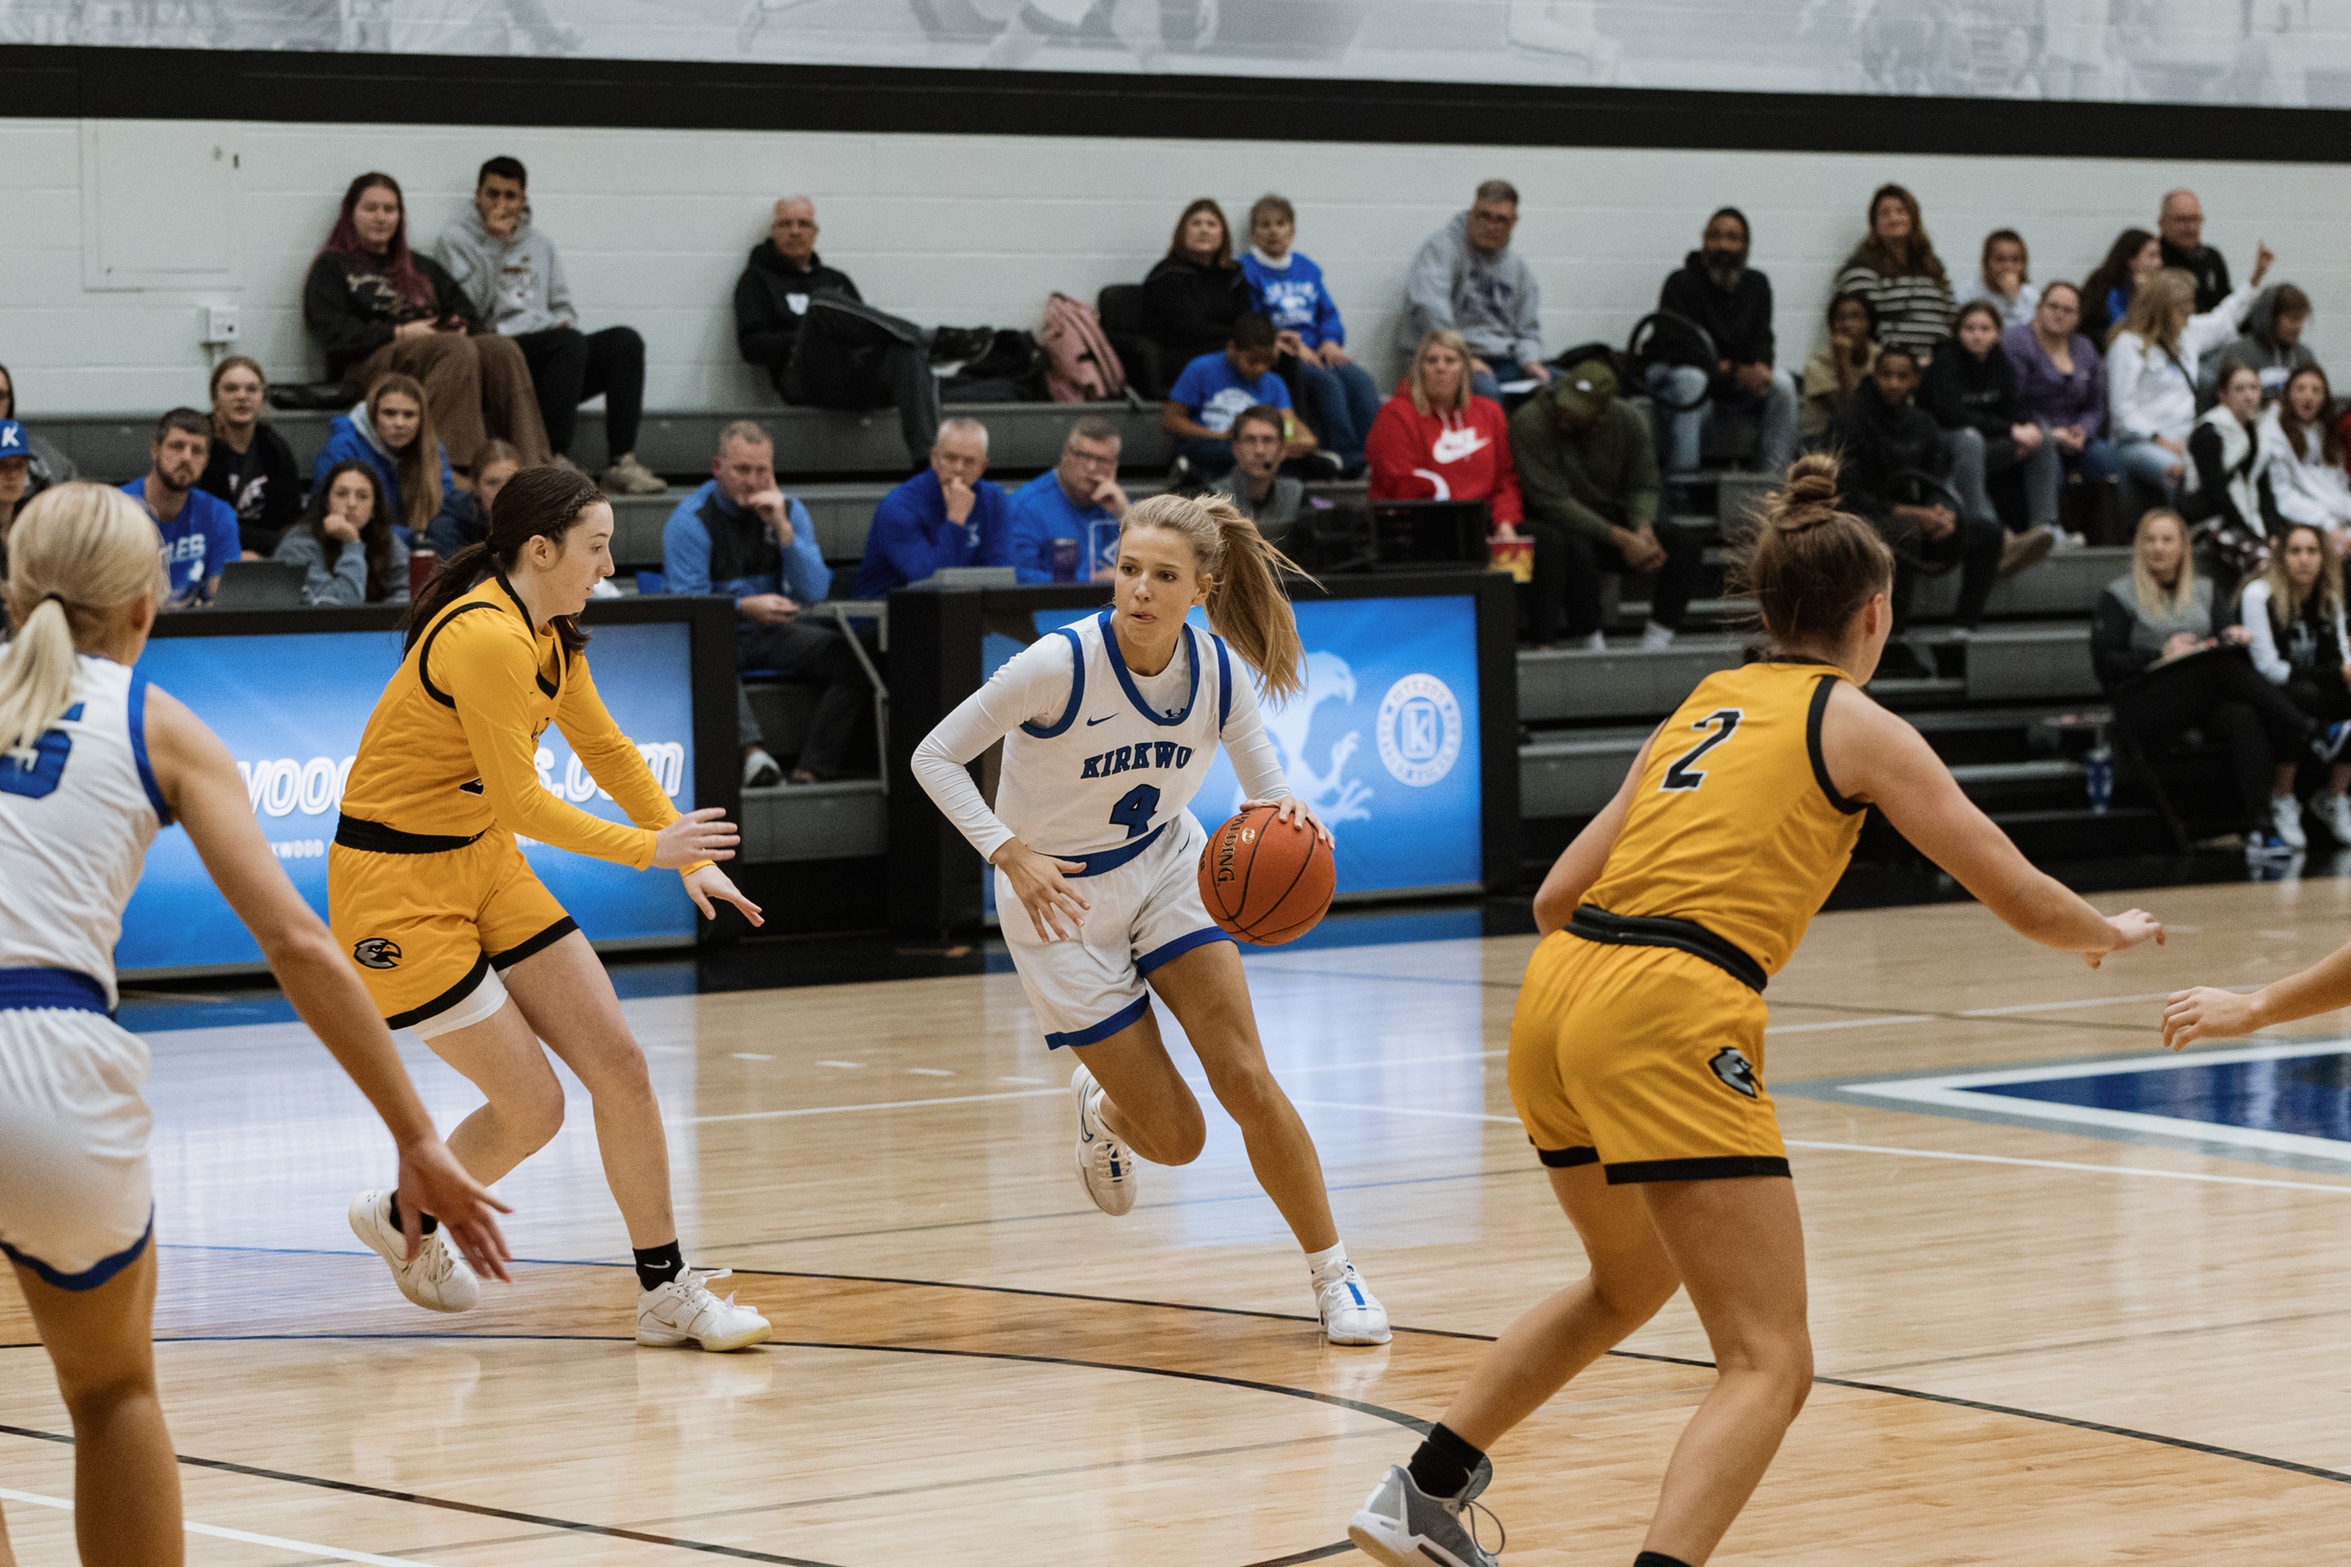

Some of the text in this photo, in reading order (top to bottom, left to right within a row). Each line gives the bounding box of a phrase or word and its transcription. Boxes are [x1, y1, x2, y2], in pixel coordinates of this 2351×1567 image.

[2, 421, 21, 448] K
[1080, 741, 1197, 779] KIRKWO
[1658, 708, 1744, 793] 2
[1109, 784, 1161, 840] 4
